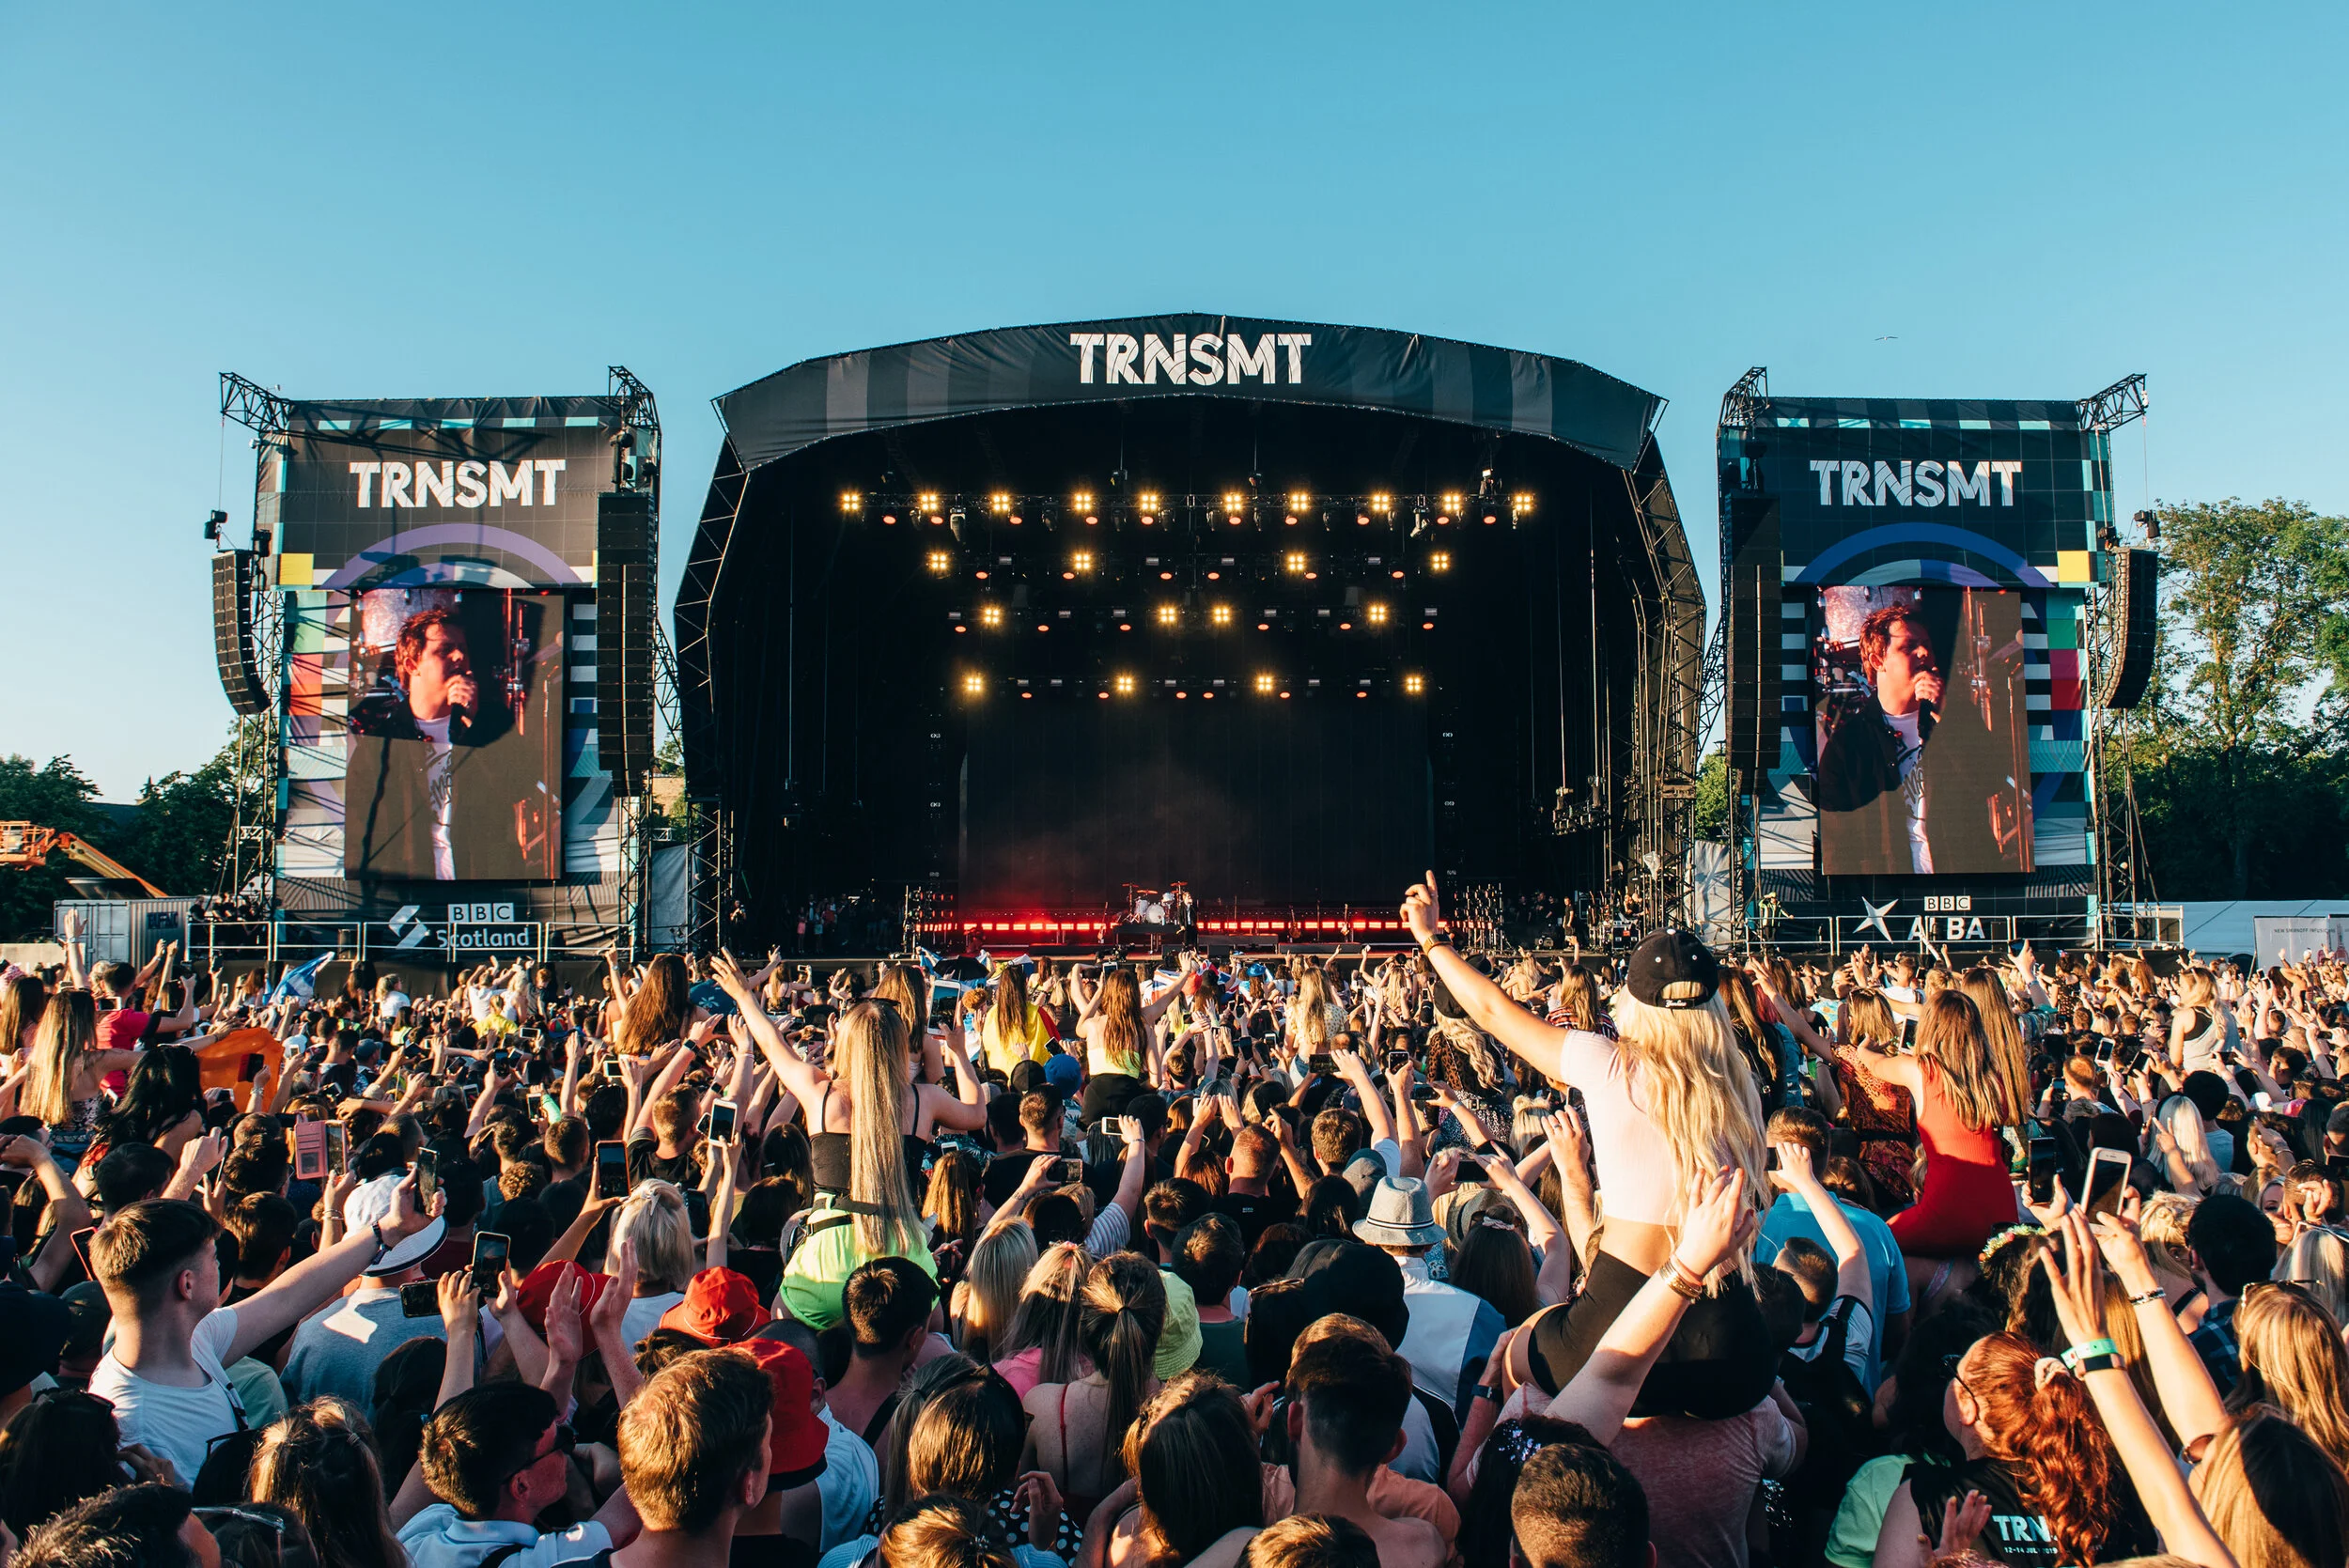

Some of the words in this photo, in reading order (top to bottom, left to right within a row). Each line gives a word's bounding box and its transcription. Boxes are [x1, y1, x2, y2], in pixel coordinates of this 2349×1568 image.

[1069, 333, 1312, 386] TRNSMT
[349, 458, 567, 508] TRNSMT
[1810, 459, 2022, 507] TRNSMT
[450, 904, 513, 922] BBC
[1925, 896, 1971, 910] BBC
[436, 927, 529, 948] Scotland
